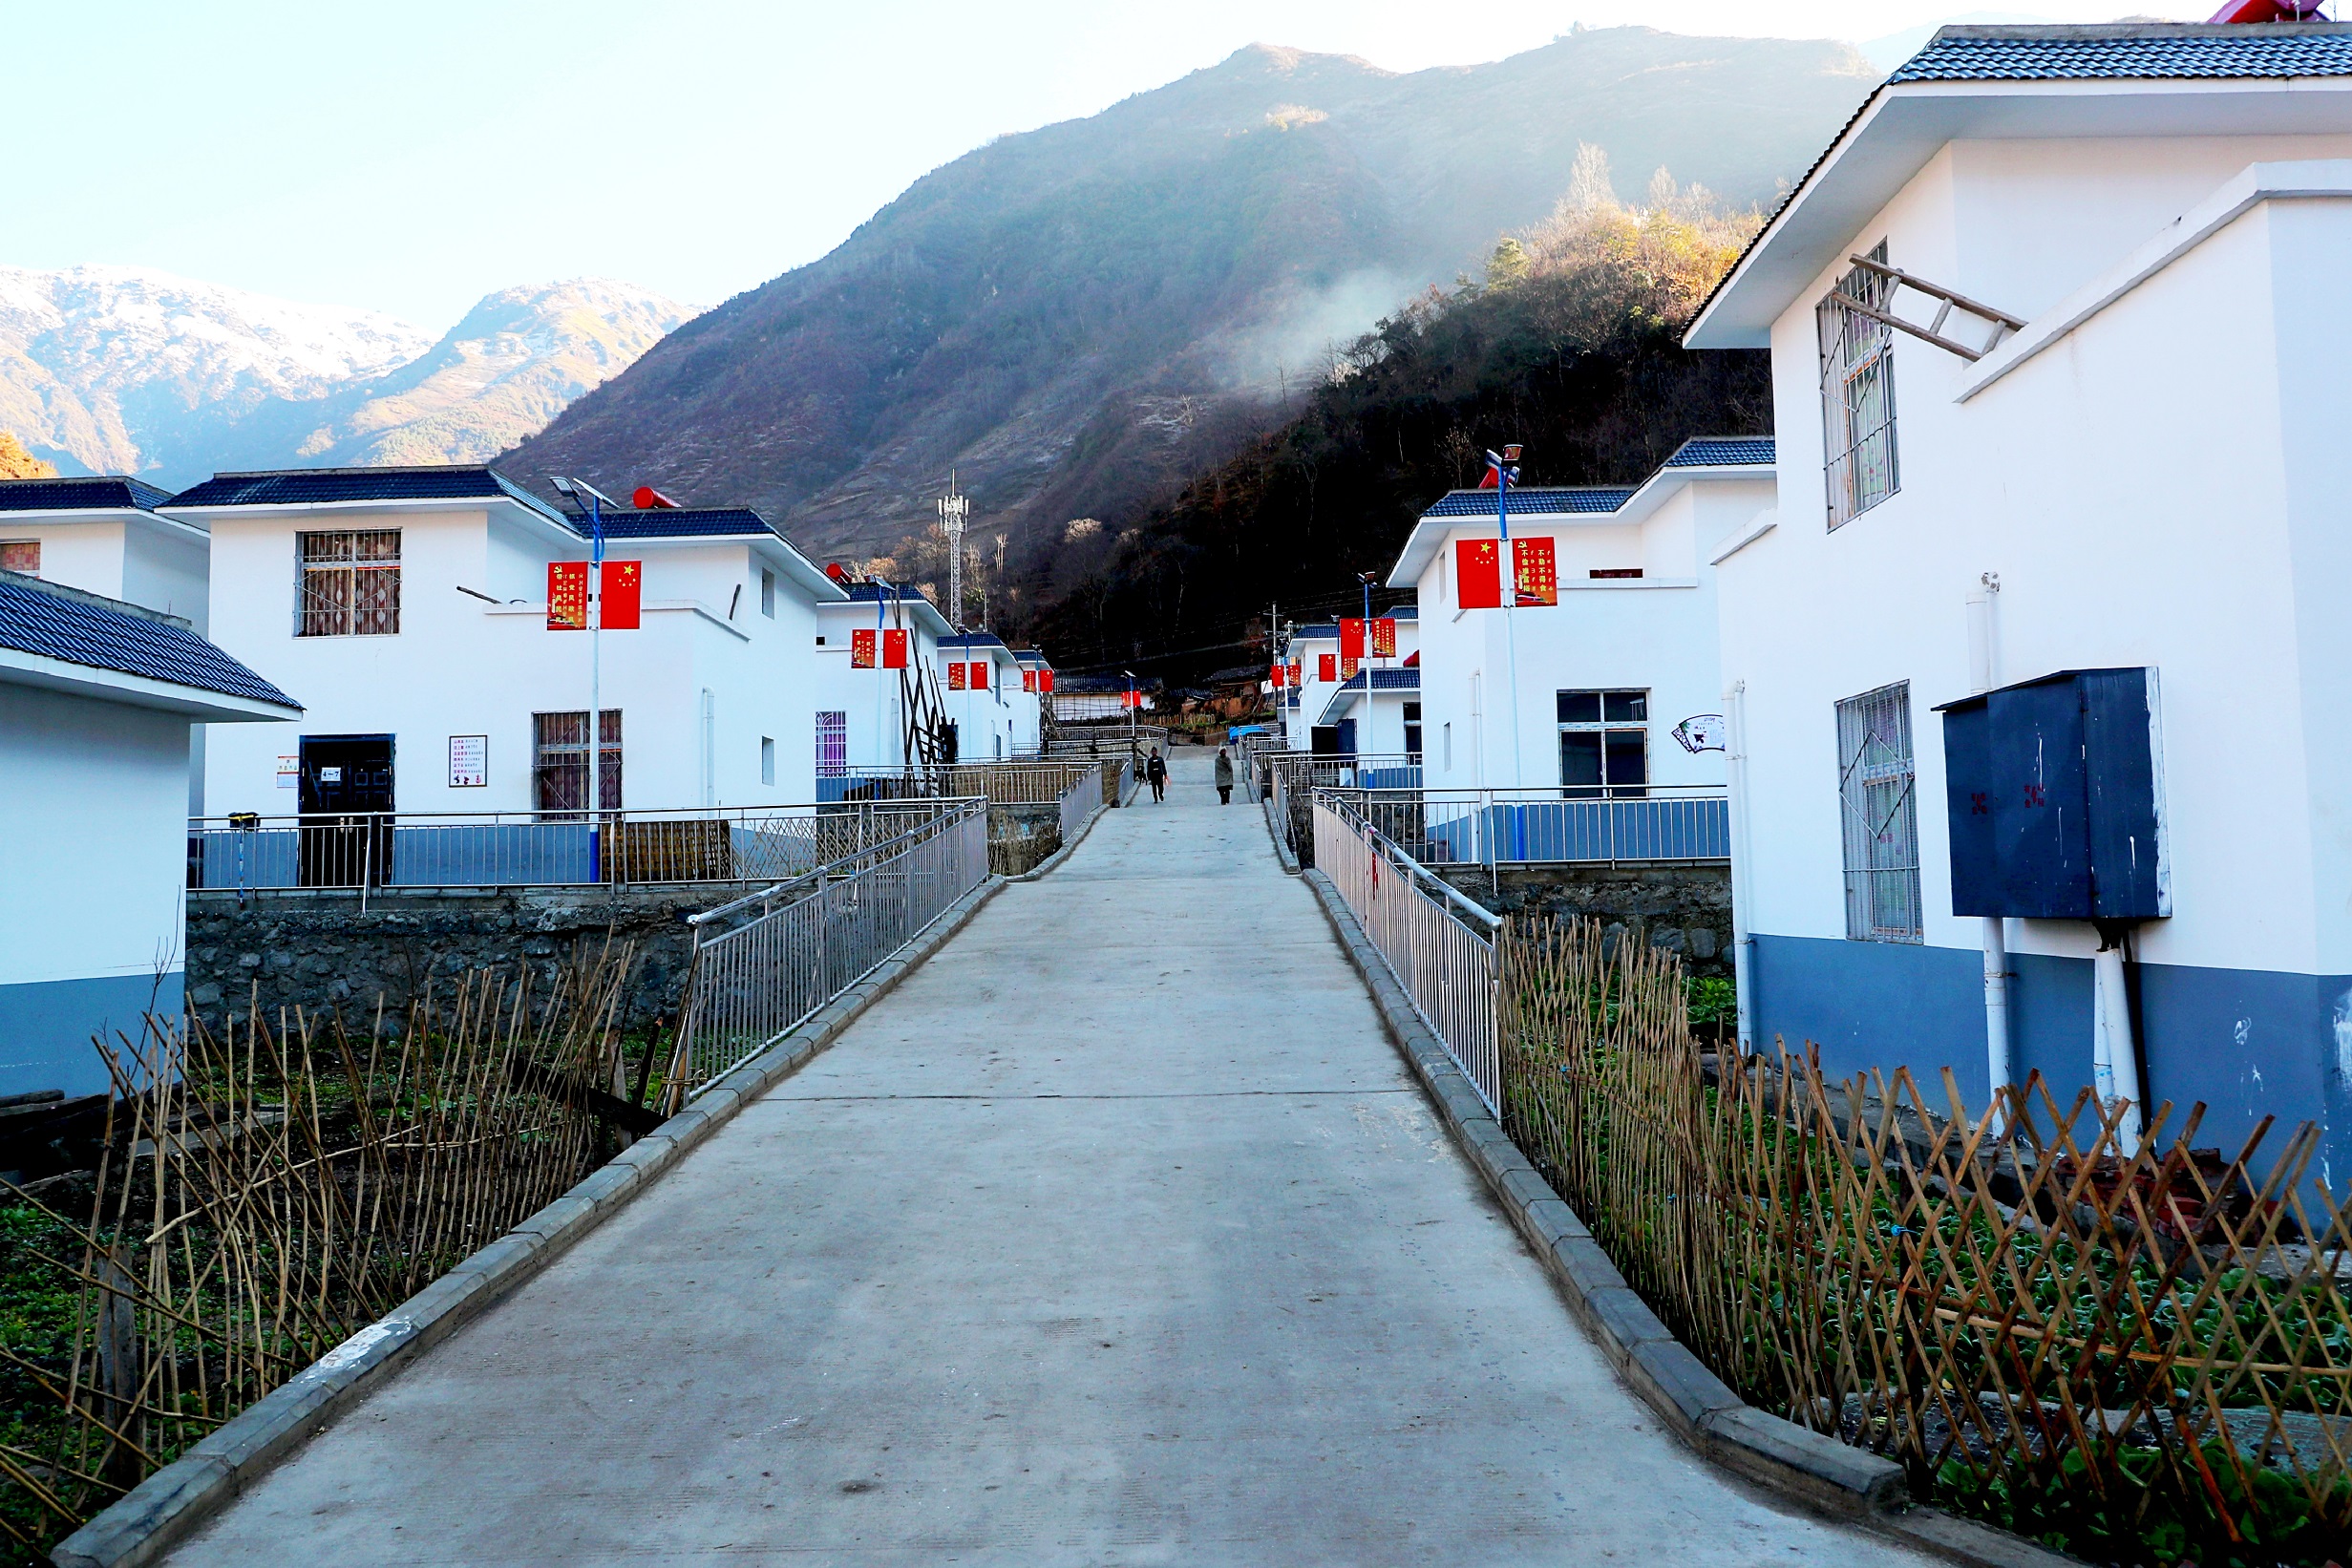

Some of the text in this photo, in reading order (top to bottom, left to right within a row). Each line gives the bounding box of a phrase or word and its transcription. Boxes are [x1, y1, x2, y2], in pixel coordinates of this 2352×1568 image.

[1538, 550, 1547, 592] 不勤不得食
